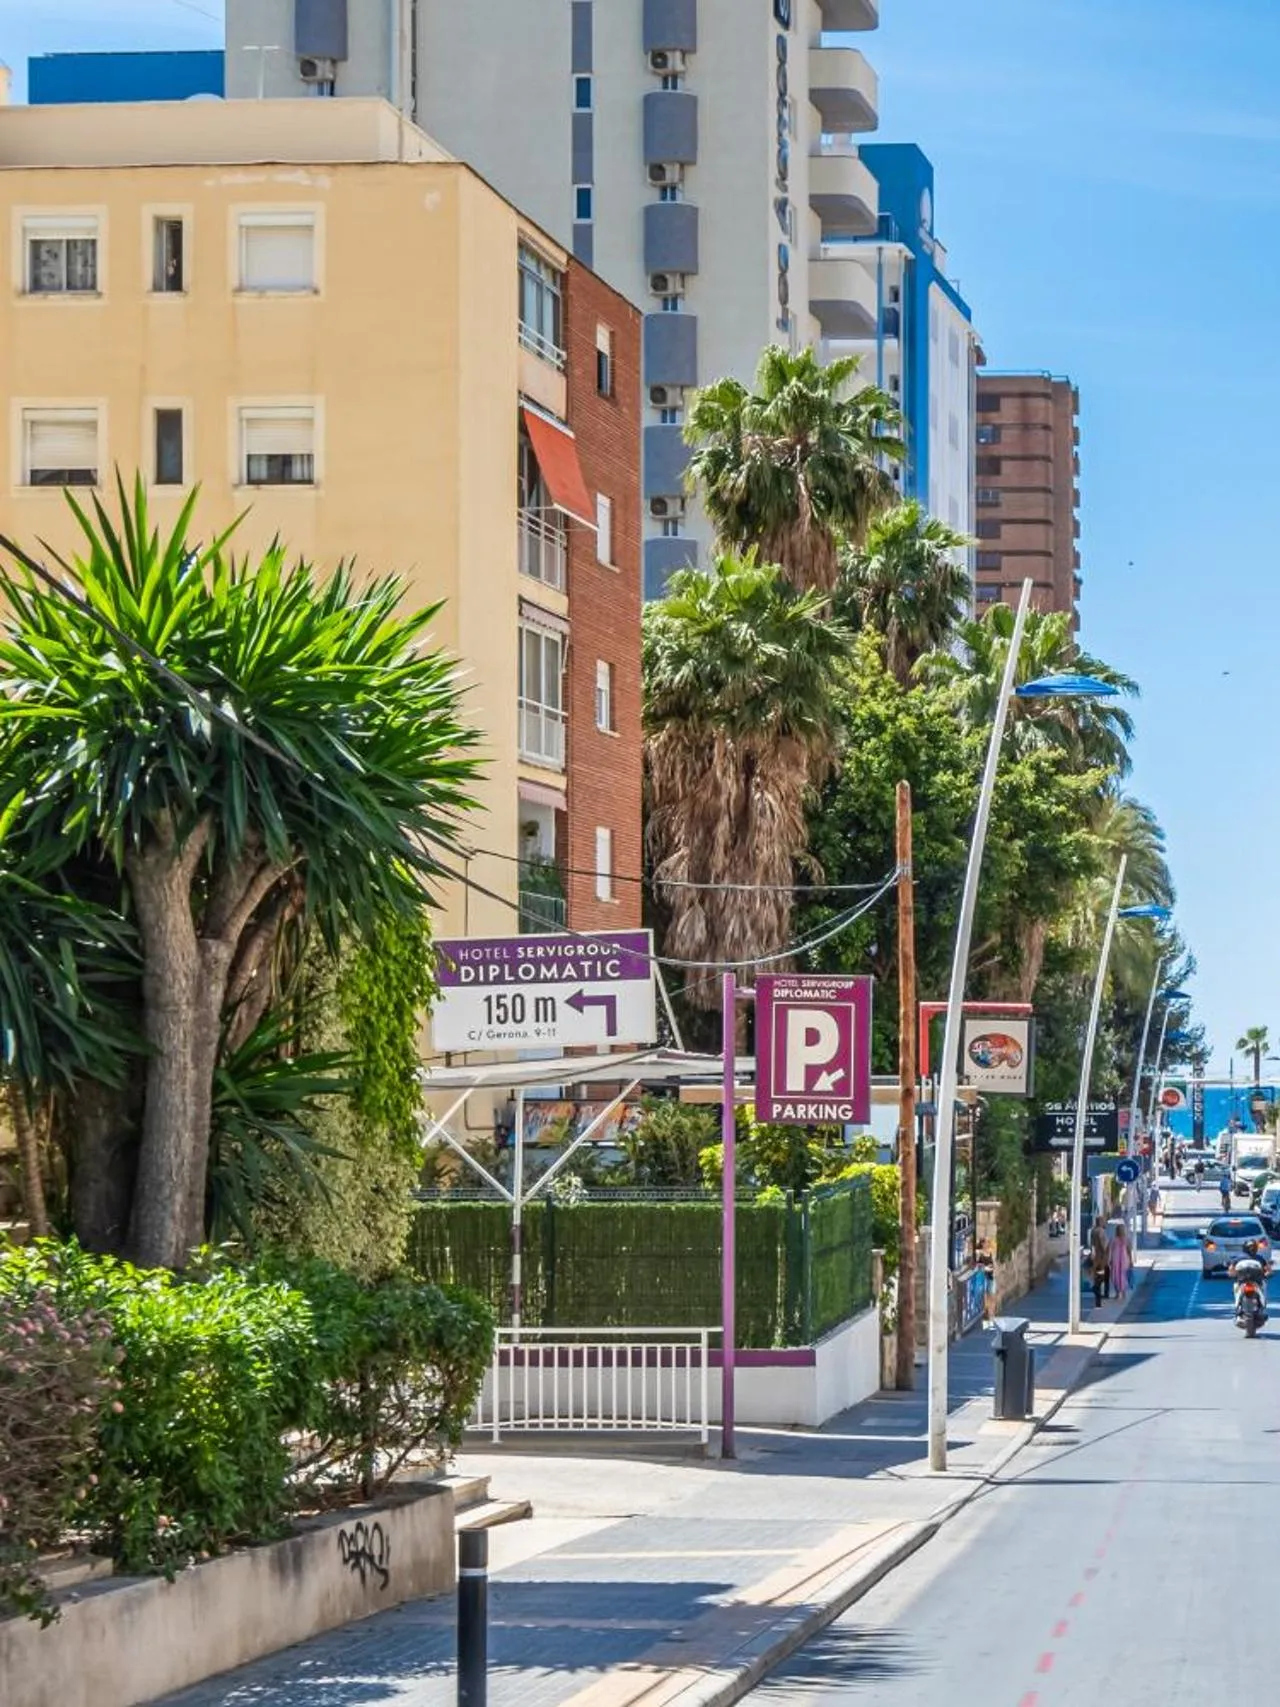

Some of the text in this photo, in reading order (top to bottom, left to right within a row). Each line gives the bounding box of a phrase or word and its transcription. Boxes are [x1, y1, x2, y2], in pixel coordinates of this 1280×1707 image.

[459, 943, 620, 961] HOTEL SERVIGROUP
[460, 959, 621, 983] DIPLOMATIC
[801, 980, 855, 989] SERVIGROUP
[773, 988, 837, 999] DIPLOMATIC
[483, 993, 556, 1025] 150 m
[534, 1028, 557, 1038] 9-11
[786, 1009, 839, 1091] P
[772, 1104, 854, 1120] PARKING
[1055, 1116, 1098, 1126] HOEL
